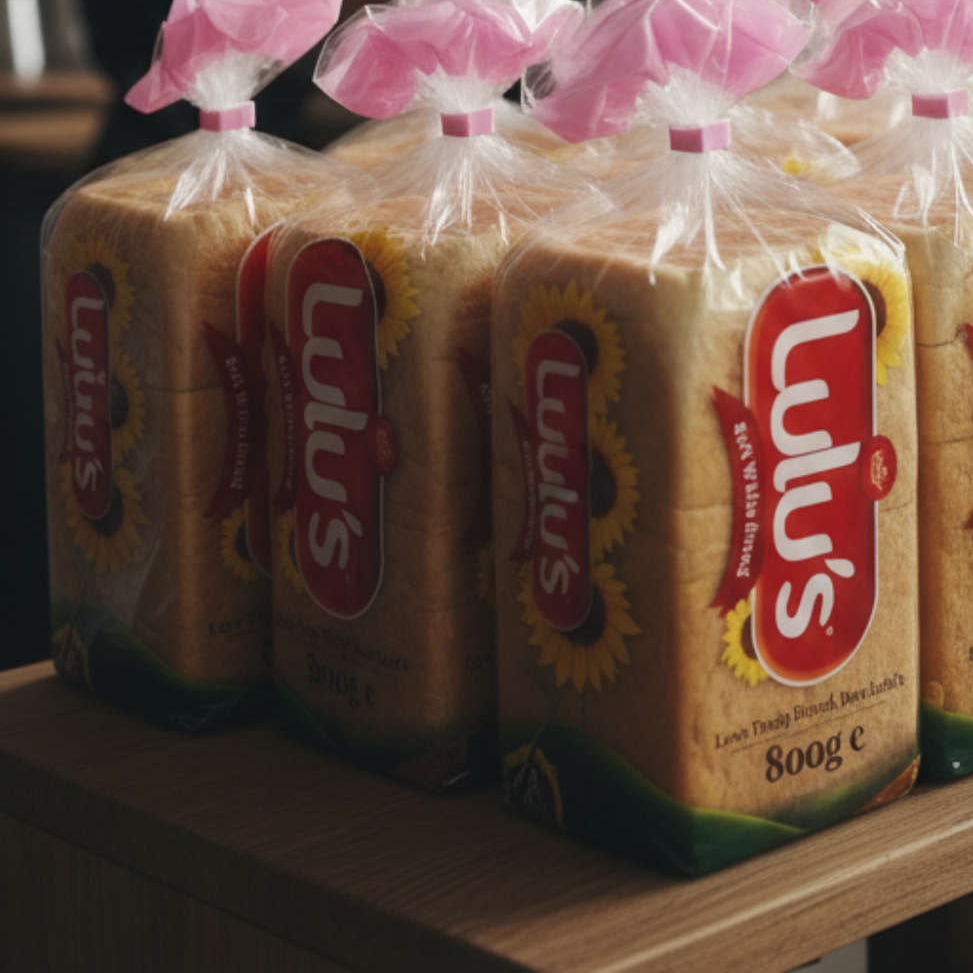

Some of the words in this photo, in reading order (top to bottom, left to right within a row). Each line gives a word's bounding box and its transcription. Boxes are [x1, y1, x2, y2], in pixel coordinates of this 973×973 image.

[302, 282, 369, 571] Lulu's
[770, 310, 861, 639] Lulu's
[766, 733, 843, 783] 800g
